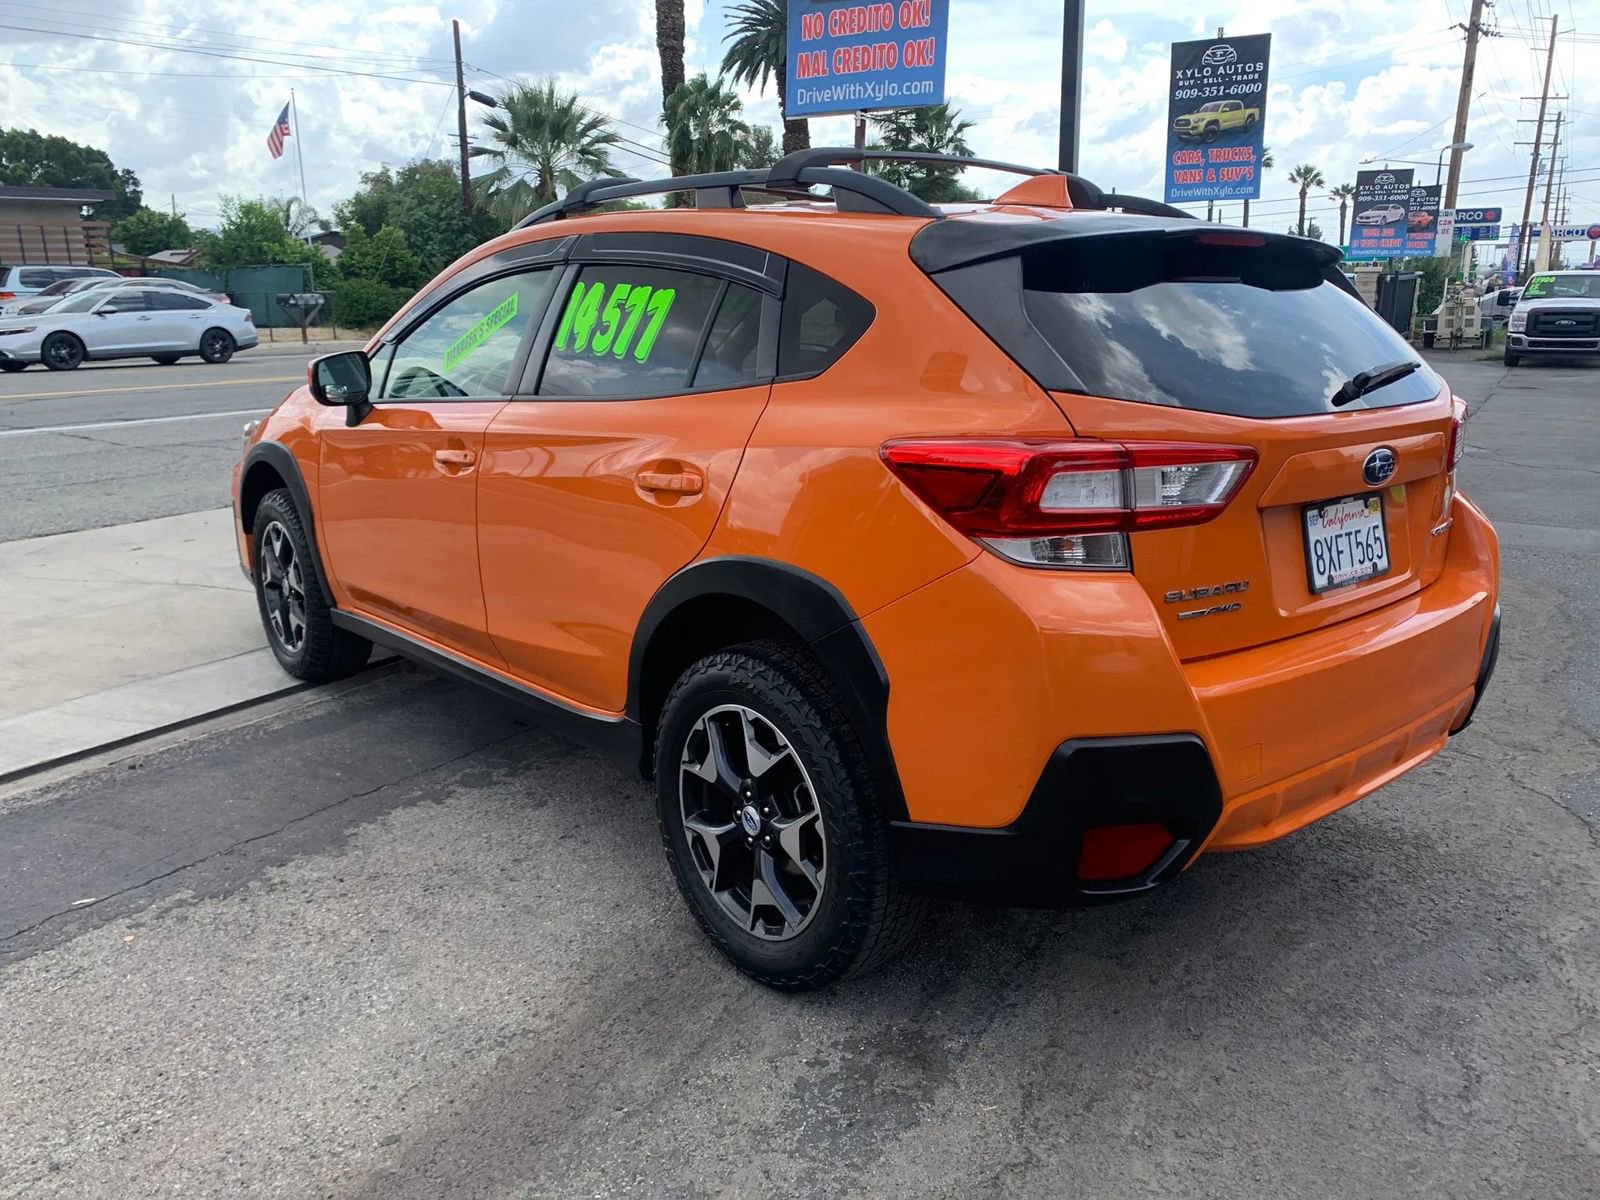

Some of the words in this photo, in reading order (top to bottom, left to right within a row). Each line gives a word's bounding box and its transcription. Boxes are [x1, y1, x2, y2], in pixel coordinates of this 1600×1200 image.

[802, 12, 824, 41] NO
[828, 4, 894, 38] CREDITO
[899, 0, 931, 29] OK!
[796, 50, 829, 80] MAL
[832, 41, 898, 76] CREDITO
[904, 37, 935, 68] OK!
[1176, 66, 1212, 79] XYLO
[1217, 62, 1264, 75] AUTOS
[1203, 76, 1222, 84] SELL
[1232, 73, 1259, 81] TRADE
[797, 80, 934, 105] DriveWithXylo.com
[1174, 82, 1262, 100] 909-351-6000
[1173, 150, 1205, 166] CARS,
[1208, 146, 1256, 164] TRUCKS,
[1174, 169, 1203, 184] VANS
[1206, 168, 1215, 182] &
[1219, 166, 1254, 181] SUV'S
[1171, 186, 1254, 198] DriveWithXylo.com
[486, 297, 516, 331] SPECIAL
[555, 281, 676, 363] 14577
[1322, 505, 1369, 530] California
[1314, 524, 1383, 575] 8XFT565
[1333, 565, 1372, 582] dmv.ca.gov
[1165, 580, 1249, 602] SUBARU
